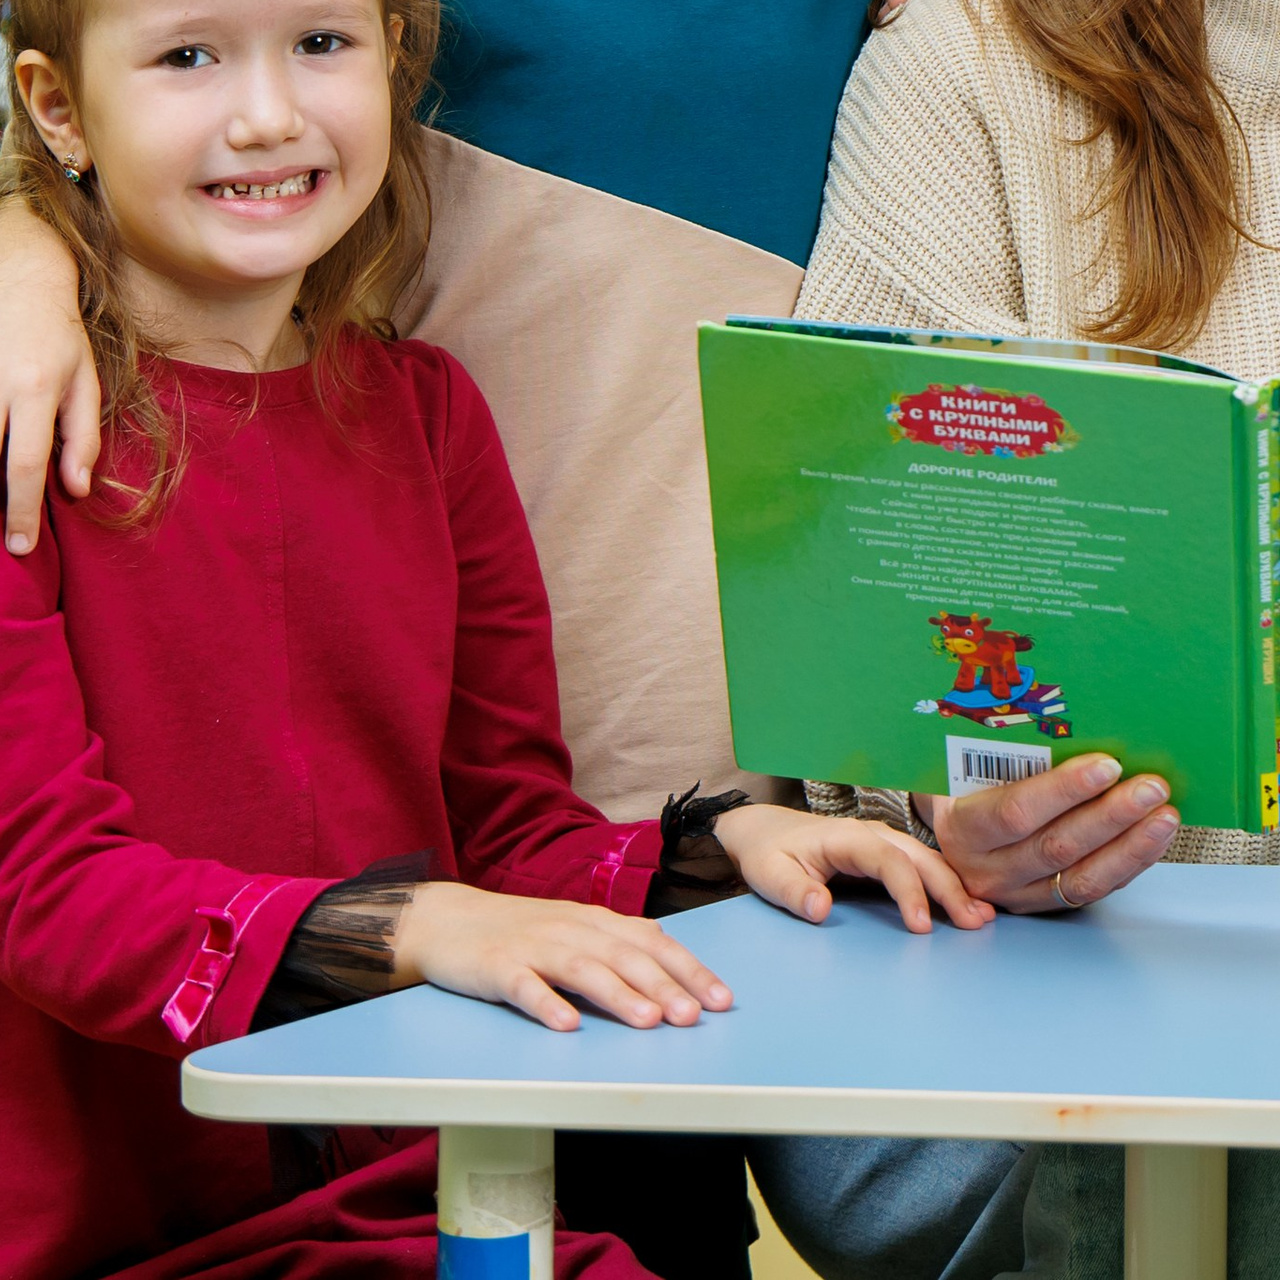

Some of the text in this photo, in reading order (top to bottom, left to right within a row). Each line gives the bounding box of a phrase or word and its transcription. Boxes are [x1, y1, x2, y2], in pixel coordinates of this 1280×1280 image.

[940, 395, 1017, 415] КНИГИ
[909, 408, 1049, 434] С КРУПНЫМИ
[933, 424, 1031, 446] БУКВАМИ
[1257, 429, 1270, 468] КНИГИ
[908, 463, 1058, 487] ДОРОГИЕ РОДИТЕЛИ!
[1258, 483, 1271, 545] КРУПНЫМИ
[1259, 551, 1272, 602] БУКВАМИ
